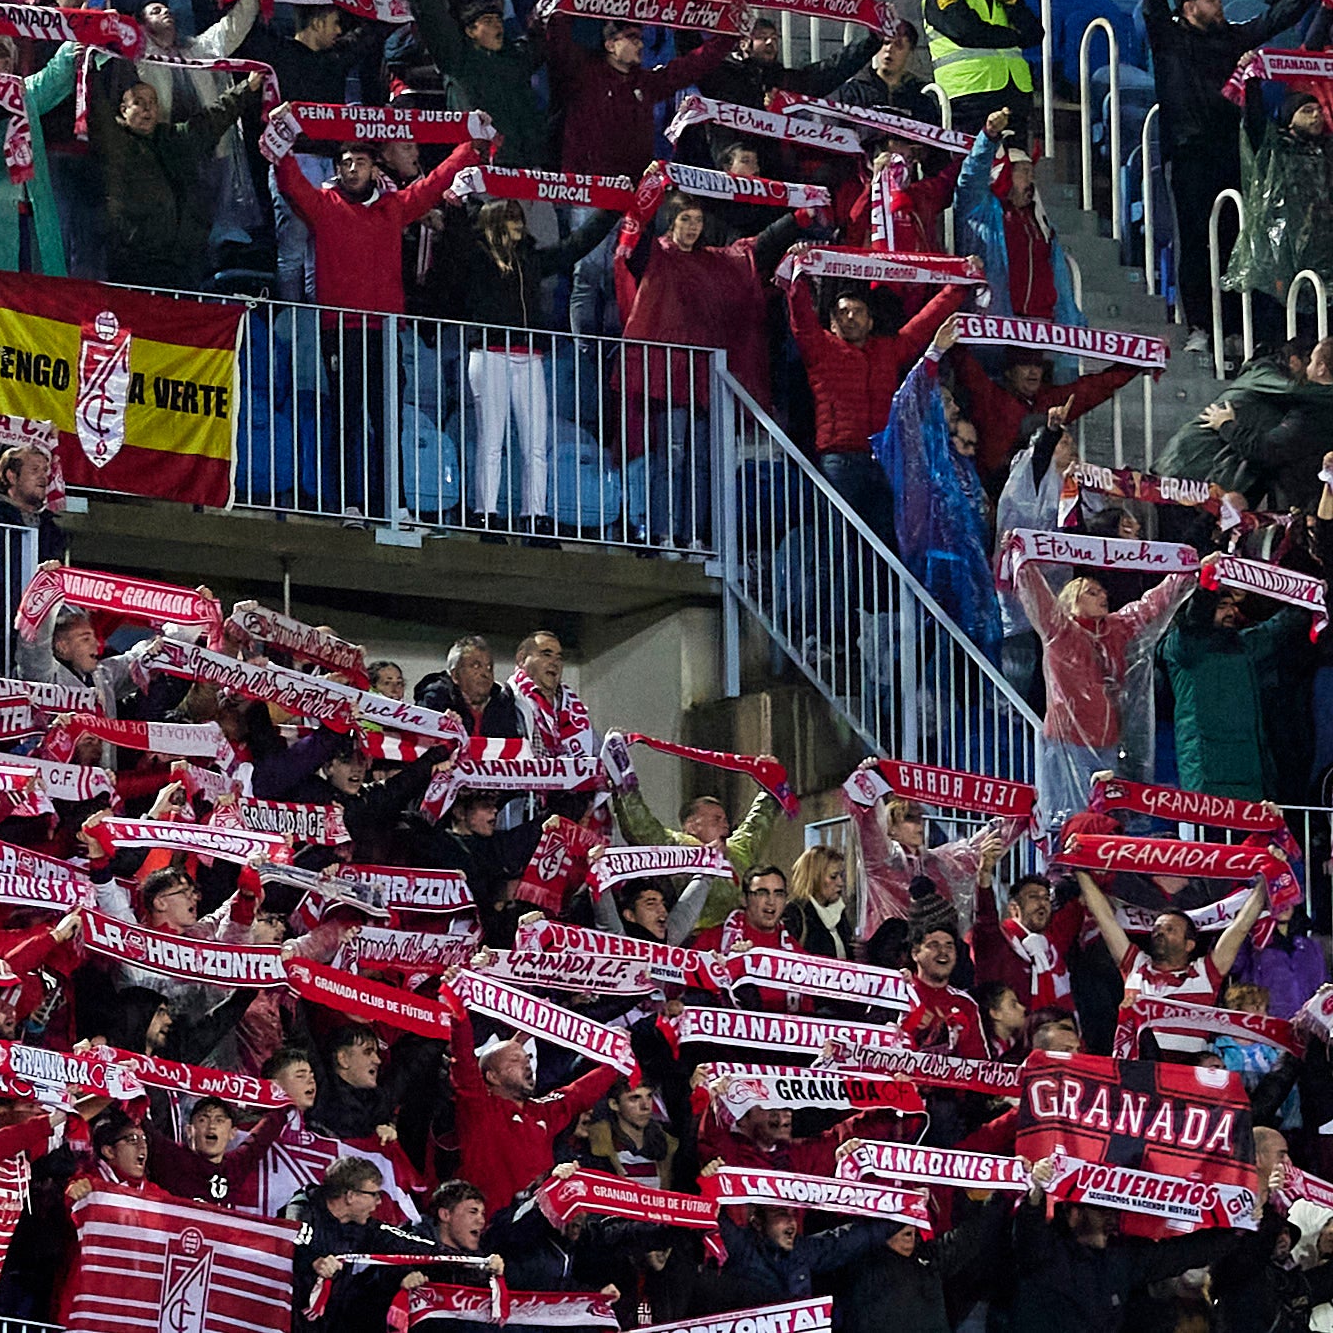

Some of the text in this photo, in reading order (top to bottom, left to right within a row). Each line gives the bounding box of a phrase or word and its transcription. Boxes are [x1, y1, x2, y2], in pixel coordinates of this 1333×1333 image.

[661, 1, 678, 21] de
[1269, 57, 1320, 74] GRANADA
[299, 105, 463, 124] PEÑA FUERA DE JUEGO
[355, 122, 414, 140] DURCAL
[524, 169, 594, 187] FUERA DE
[538, 183, 592, 204] DURCAL
[666, 164, 766, 198] GRANADA
[968, 317, 1148, 361] GRANADINISTA
[130, 376, 145, 403] A
[153, 380, 228, 420] VERTE
[1034, 533, 1168, 565] Eterna Lucha
[974, 780, 1017, 808] 1931
[240, 801, 325, 838] GRANADA CF
[551, 926, 698, 971] VOLVEREMOS
[472, 983, 614, 1056] GRANADINISTA
[9, 1046, 90, 1086] GRANADA
[776, 1079, 880, 1100] GRANADA
[1030, 1078, 1233, 1153] GRANADA
[1077, 1165, 1220, 1209] VOLVEREMOS
